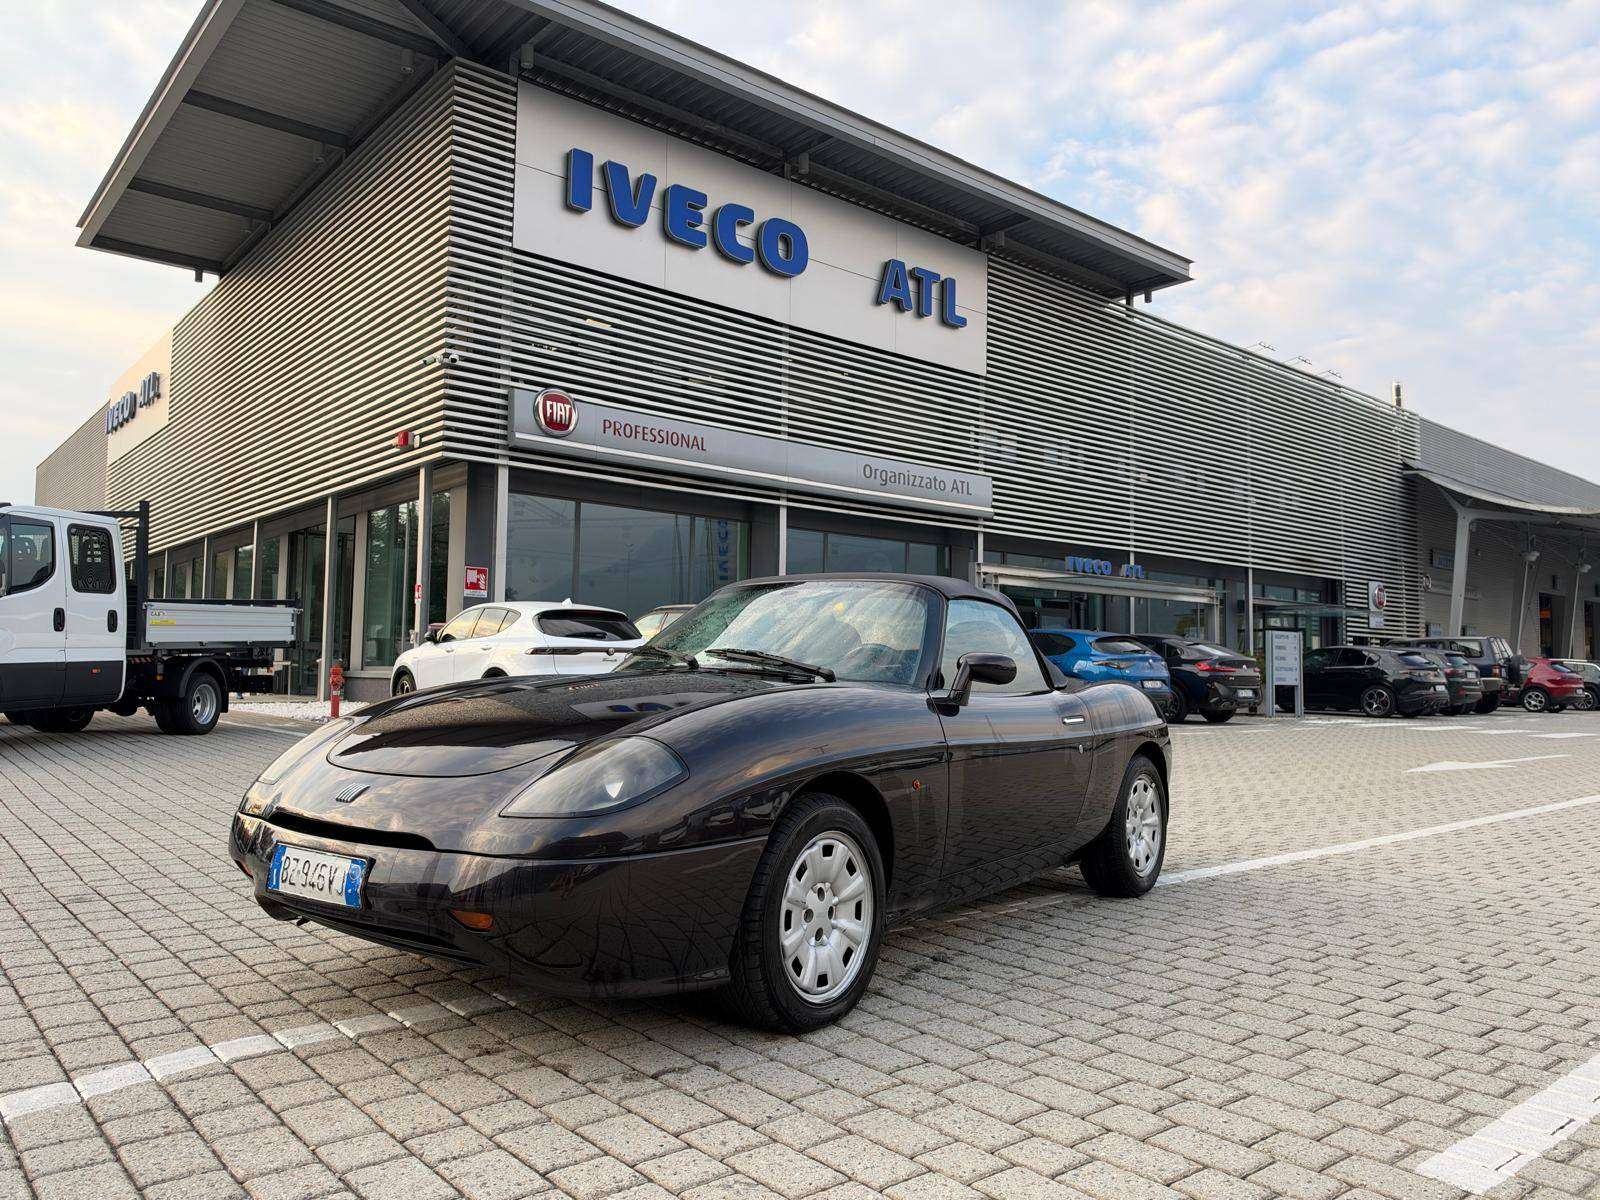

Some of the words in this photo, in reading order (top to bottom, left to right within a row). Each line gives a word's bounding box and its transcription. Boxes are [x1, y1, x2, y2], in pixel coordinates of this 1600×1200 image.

[566, 148, 809, 277] IVECO
[878, 259, 967, 328] ATL
[106, 391, 137, 434] IVECO
[546, 400, 572, 424] FIAT
[603, 419, 707, 451] PROFESSIONAL
[862, 464, 946, 491] Organizzato
[950, 479, 972, 495] ATL
[1065, 556, 1112, 575] IVECO
[1120, 564, 1145, 578] ATL
